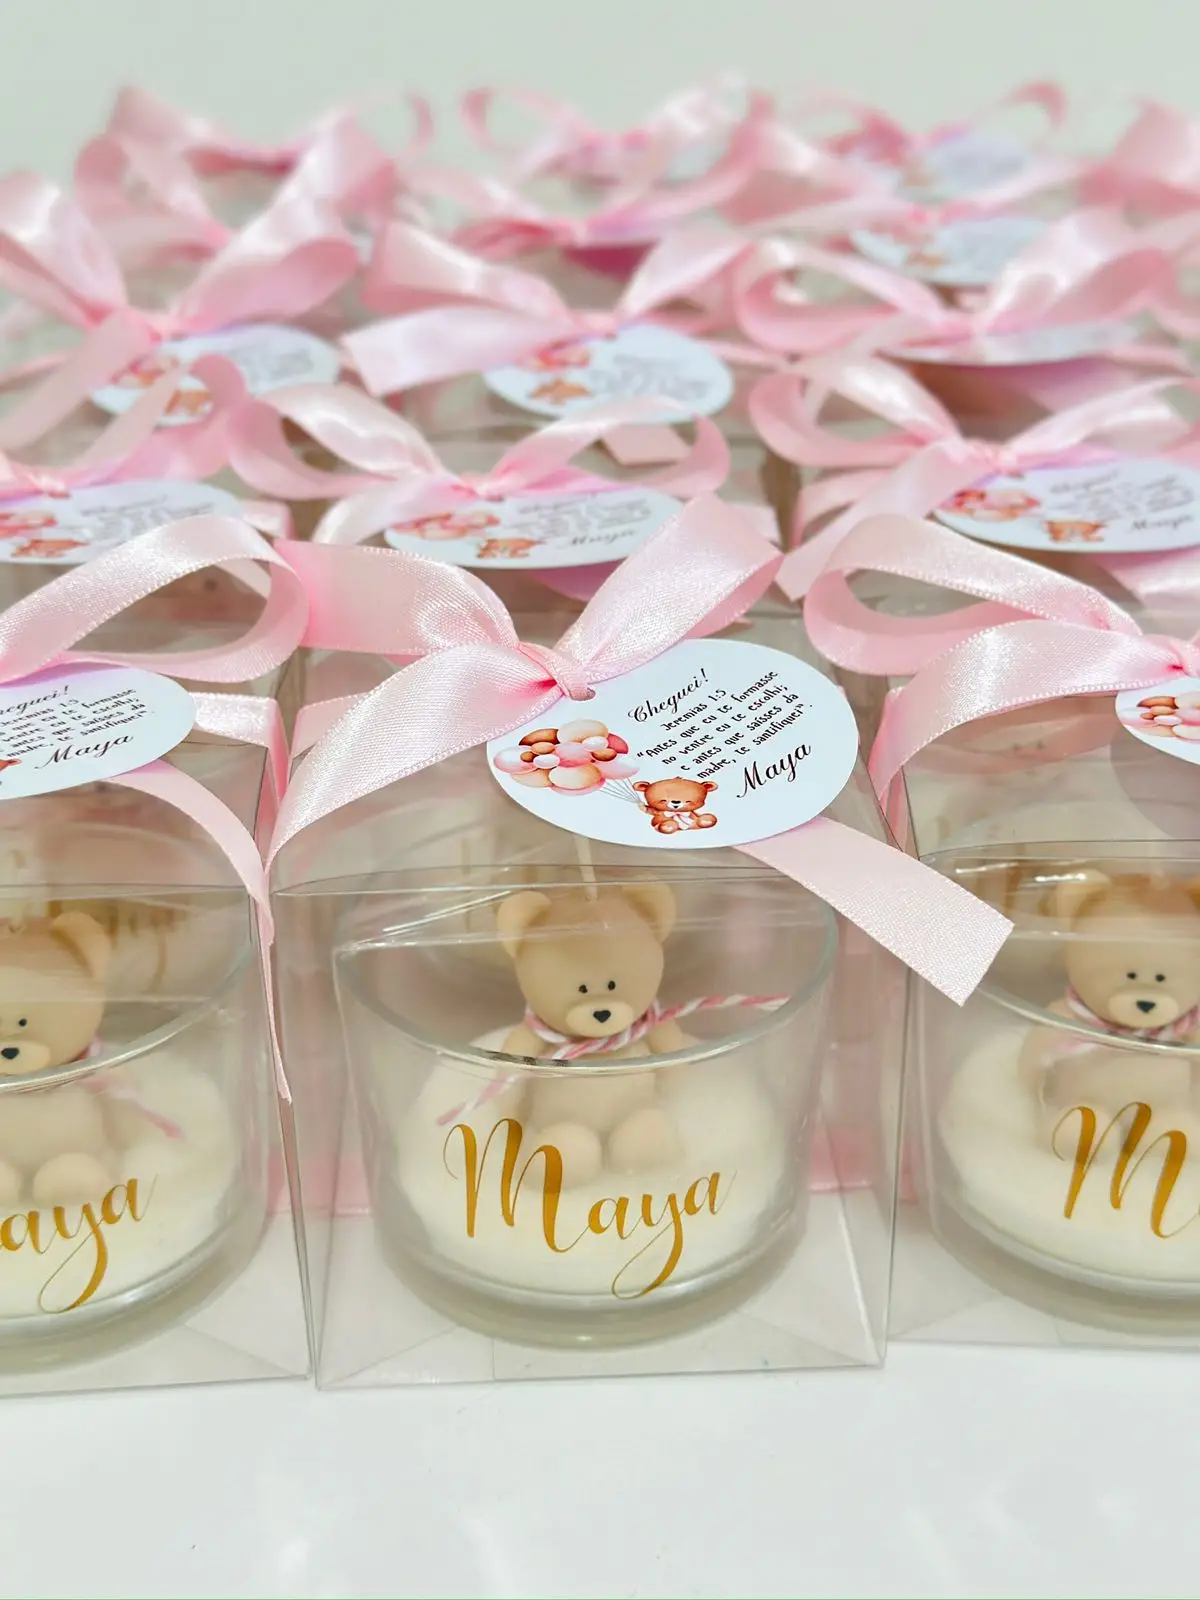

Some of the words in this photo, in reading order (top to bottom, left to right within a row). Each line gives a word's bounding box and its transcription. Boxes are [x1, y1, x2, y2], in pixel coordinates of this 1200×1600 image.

[628, 668, 708, 722] Cheguei!
[661, 703, 708, 731] Jeremias
[708, 688, 727, 702] 1:5
[680, 725, 700, 738] que
[702, 714, 718, 724] eu
[717, 704, 733, 714] te
[731, 671, 778, 703] formasse
[34, 735, 134, 769] Maya
[661, 756, 677, 765] no
[679, 734, 714, 755] ventre
[715, 723, 732, 733] eu
[731, 713, 746, 722] te
[692, 746, 722, 765] antes
[724, 732, 745, 746] que
[782, 693, 799, 704] da
[697, 758, 737, 779] madre,
[734, 746, 751, 755] te
[736, 744, 812, 798] Maya
[443, 1117, 738, 1300] Maya
[0, 1173, 158, 1315] aya
